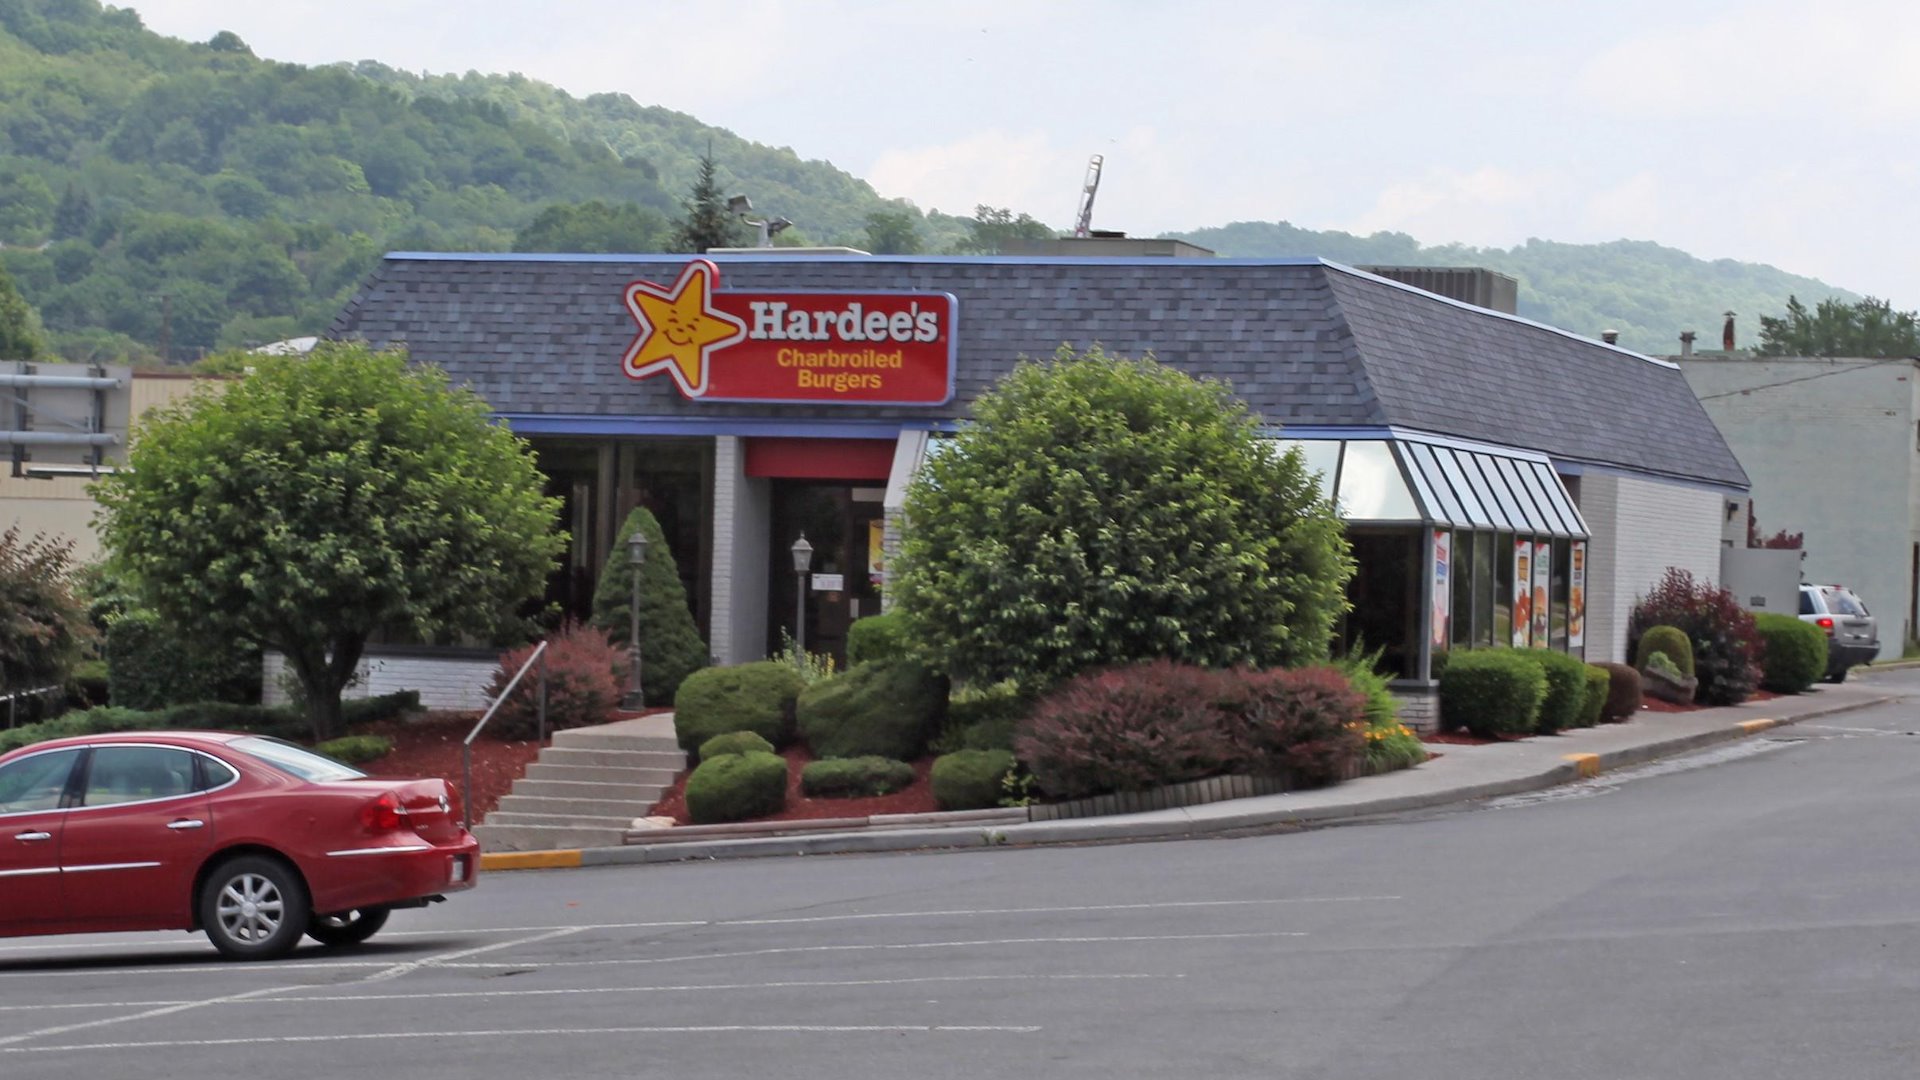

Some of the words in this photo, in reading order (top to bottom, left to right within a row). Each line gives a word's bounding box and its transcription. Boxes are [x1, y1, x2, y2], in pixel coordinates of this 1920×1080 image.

[749, 301, 938, 342] Hardee's
[777, 348, 903, 369] Charbroiled
[797, 370, 882, 392] Burgers
